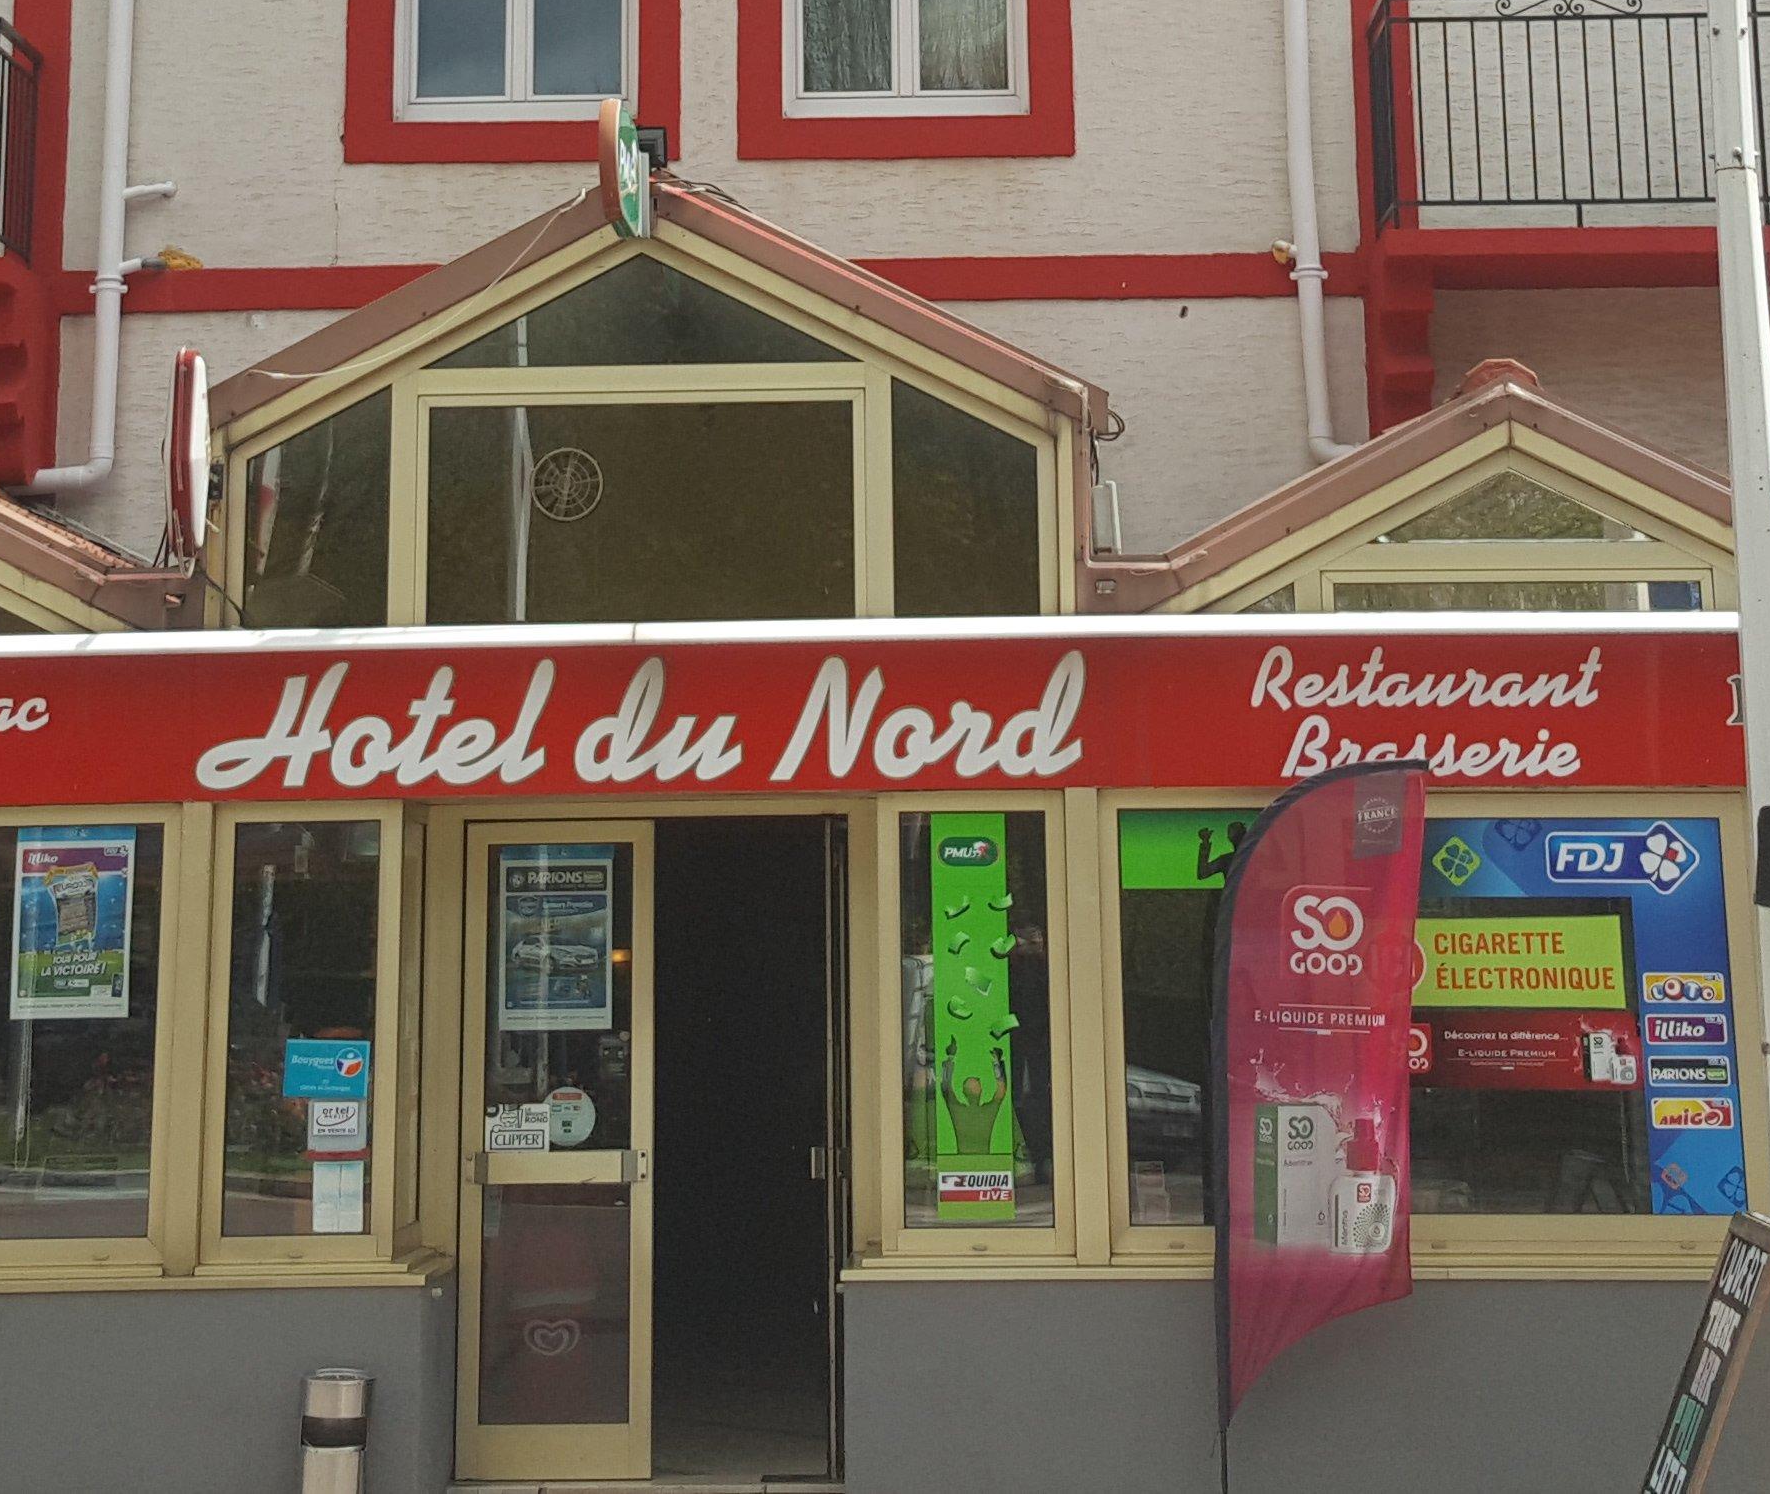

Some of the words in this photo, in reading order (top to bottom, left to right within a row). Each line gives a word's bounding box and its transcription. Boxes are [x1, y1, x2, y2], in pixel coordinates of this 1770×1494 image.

[1250, 645, 1603, 712] Restaurant
[195, 659, 557, 789] Hotel
[572, 655, 745, 785] du
[769, 648, 1087, 782] Nord
[1280, 714, 1581, 778] Brasserie
[943, 846, 973, 859] PMU
[1555, 842, 1626, 873] FDJ
[527, 871, 583, 884] PARIONS
[1291, 894, 1364, 952] SO
[1433, 932, 1565, 955] CIGARETTE
[1435, 962, 1616, 992] ÉLECTRONIQUE
[1651, 977, 1715, 1001] LOTO
[1254, 1009, 1324, 1025] E-LIQUIDE
[1330, 1012, 1387, 1027] PREMIUM
[1444, 1030, 1496, 1040] Découvrez
[1498, 1031, 1508, 1040] la
[1654, 1019, 1706, 1040] illiko
[291, 1055, 335, 1066] Bouygues
[1651, 1067, 1707, 1081] PARIONS
[1288, 1115, 1314, 1140] SO
[1659, 1109, 1721, 1126] AMIGO
[494, 1134, 539, 1146] CLIPPER
[979, 1190, 1010, 1201] LIVE
[1719, 1237, 1769, 1307] OUVERT
